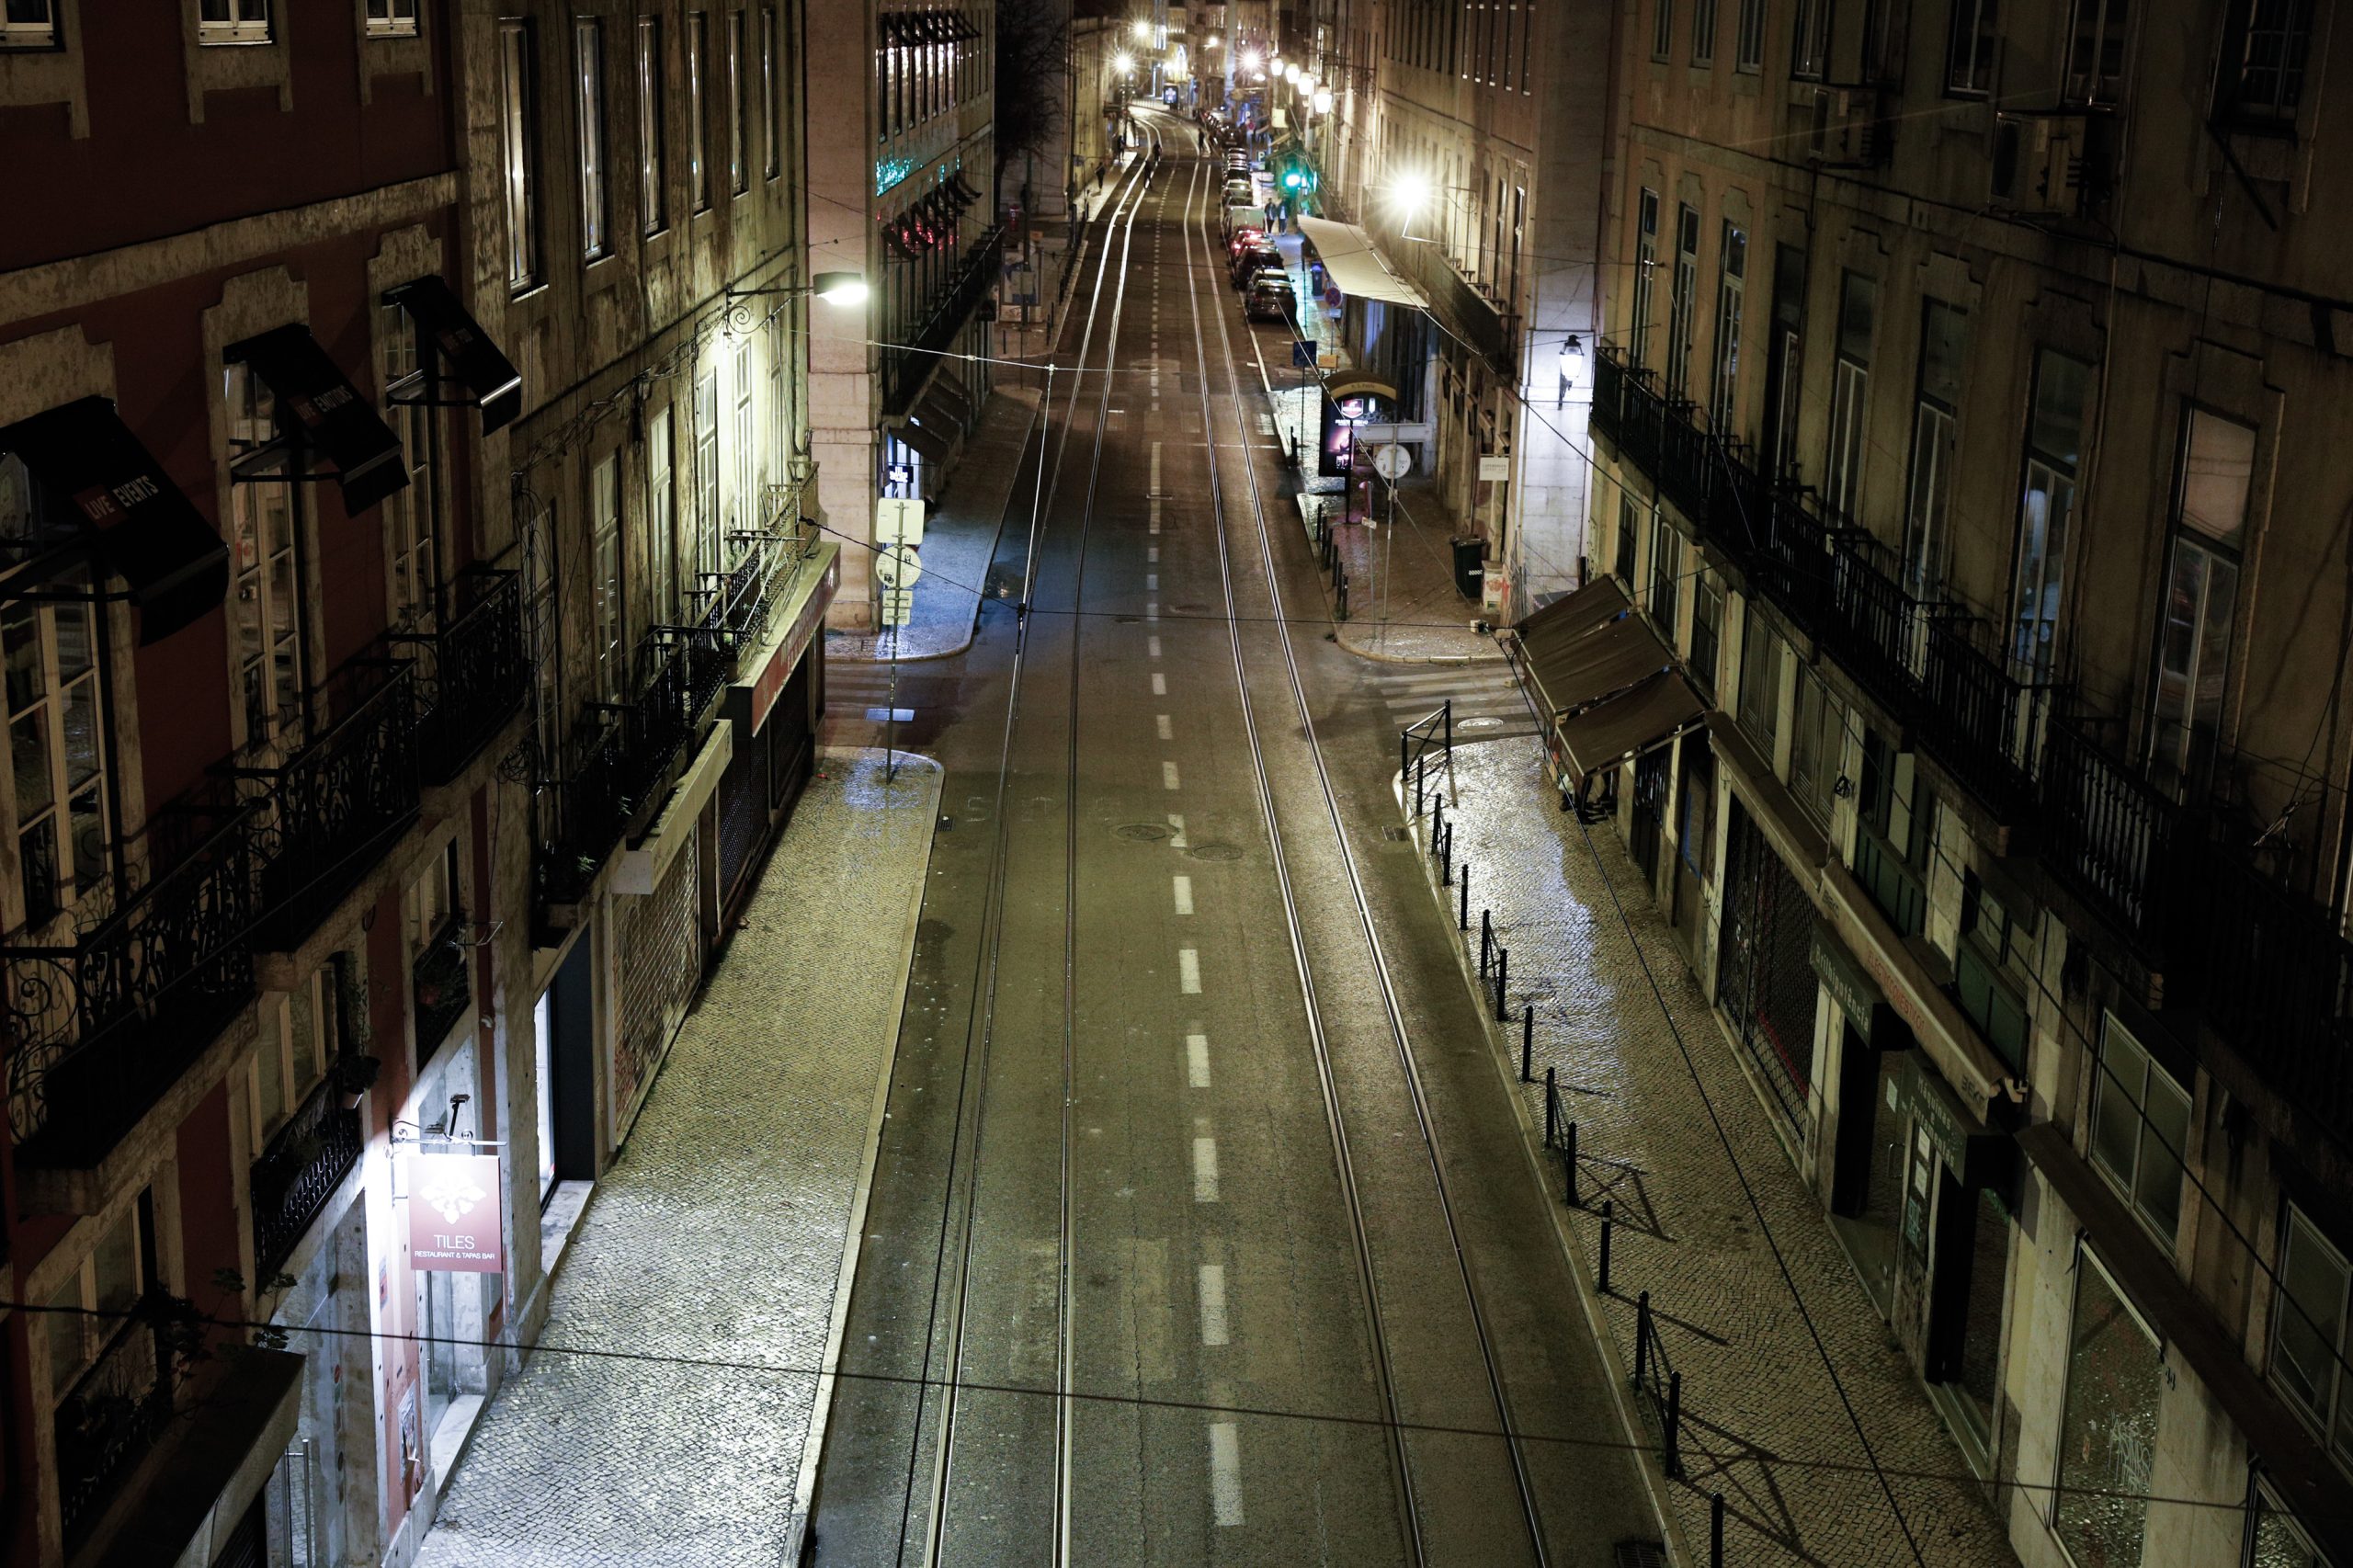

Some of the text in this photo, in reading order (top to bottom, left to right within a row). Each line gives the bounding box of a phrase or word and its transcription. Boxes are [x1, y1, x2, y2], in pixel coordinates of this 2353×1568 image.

[85, 474, 160, 520] LIVE EVENTS
[434, 1234, 475, 1249] TILES
